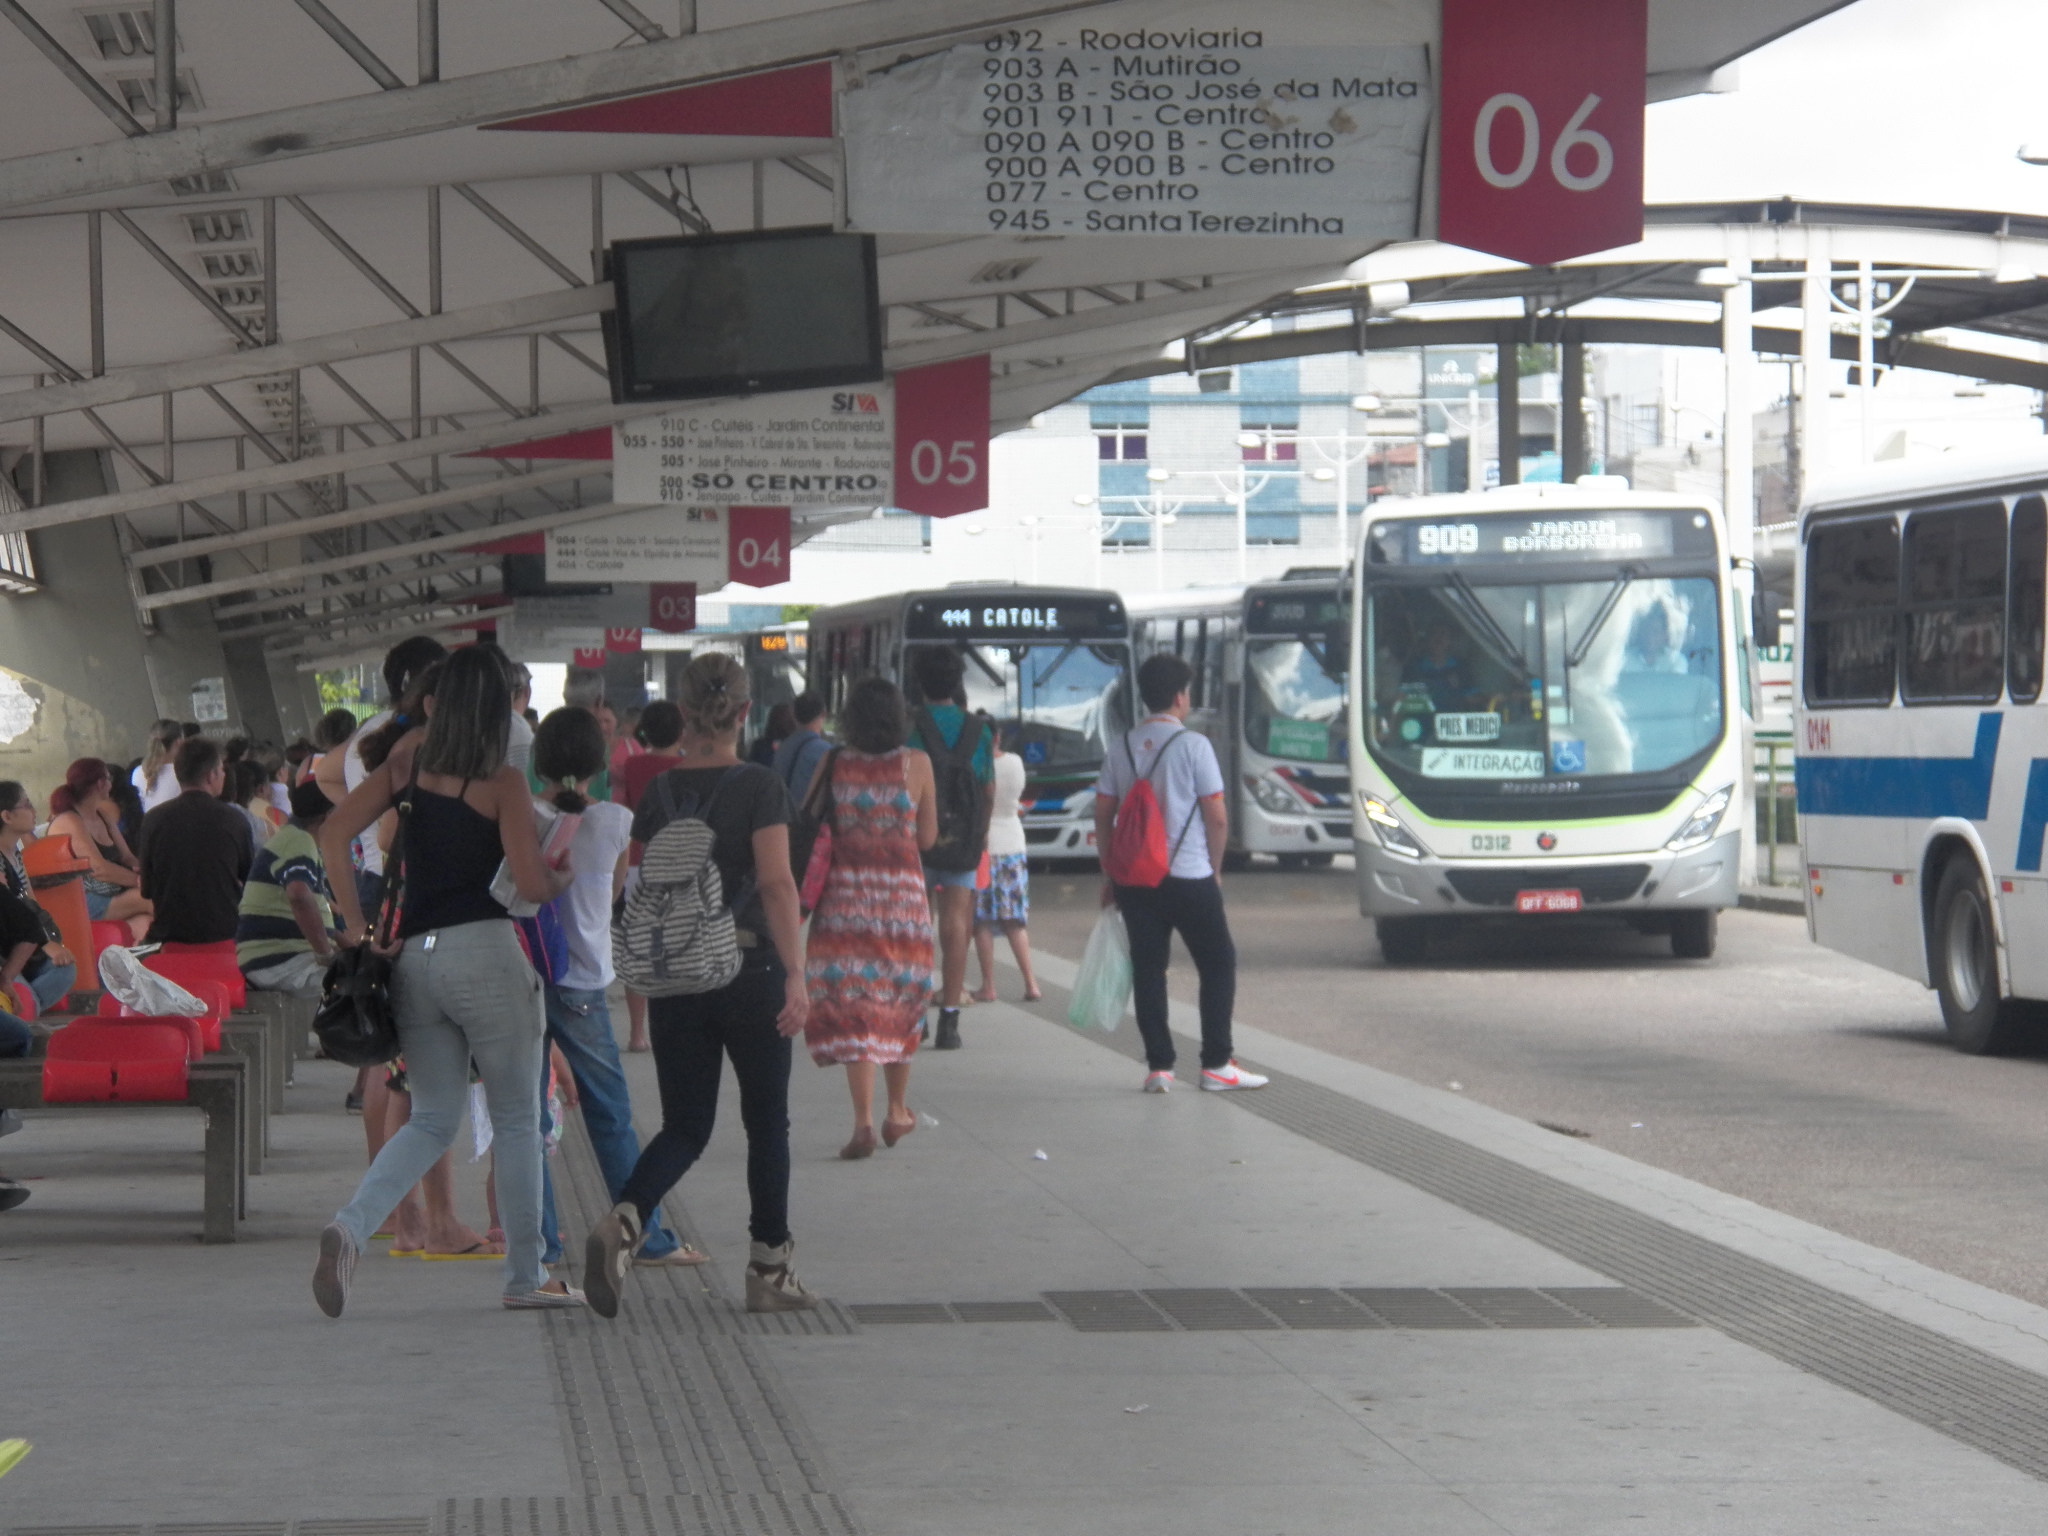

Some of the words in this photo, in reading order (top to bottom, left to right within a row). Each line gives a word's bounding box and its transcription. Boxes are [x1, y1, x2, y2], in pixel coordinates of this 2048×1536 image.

[1080, 27, 1263, 51] Rodoviaria
[983, 57, 1044, 80] 903
[1055, 57, 1079, 78] A
[1113, 54, 1241, 77] Mutirão
[983, 82, 1044, 103] 903
[1058, 82, 1075, 102] B
[1111, 79, 1174, 102] São
[1185, 77, 1262, 101] José
[1274, 78, 1319, 99] da
[1332, 77, 1418, 99] Mata
[983, 106, 1039, 128] 901
[1057, 104, 1113, 127] 911
[984, 131, 1046, 153] 090
[1057, 131, 1080, 152] A
[1092, 130, 1154, 152] 090
[1168, 130, 1185, 151] B
[1220, 128, 1334, 150] Centro
[1473, 91, 1615, 193] 06
[985, 156, 1047, 178] 900
[1057, 156, 1081, 177] A
[1093, 155, 1155, 177] 900
[1168, 155, 1185, 176] B
[1221, 152, 1335, 175] Centro
[986, 181, 1047, 203] 077
[1084, 179, 1199, 201] Centro
[988, 208, 1050, 231] 945
[1085, 209, 1182, 231] Santa
[1188, 210, 1344, 234] Terezinha
[660, 418, 685, 432] 910
[688, 418, 699, 432] C
[766, 419, 809, 432] Jardim
[811, 417, 884, 432] Continental
[623, 435, 647, 448] 055
[661, 435, 685, 448] 550
[661, 454, 685, 467] 505
[723, 454, 769, 468] Pinheiro
[780, 456, 822, 469] Mirante
[911, 438, 977, 485] 05
[659, 475, 683, 489] 500
[691, 467, 734, 489] SÓ
[746, 473, 878, 490] CENTRO
[659, 487, 684, 500] 910
[793, 489, 824, 503] Jardim
[827, 489, 884, 503] Continental
[1418, 524, 1480, 555] 909
[1527, 520, 1617, 536] JARDIM
[737, 539, 782, 569] 04
[1502, 533, 1643, 553] BORBOREMA
[657, 596, 691, 620] 03
[942, 609, 971, 628] 444
[983, 607, 1059, 627] CATOLE
[1806, 716, 1832, 752] 0141
[1471, 834, 1512, 851] 0312
